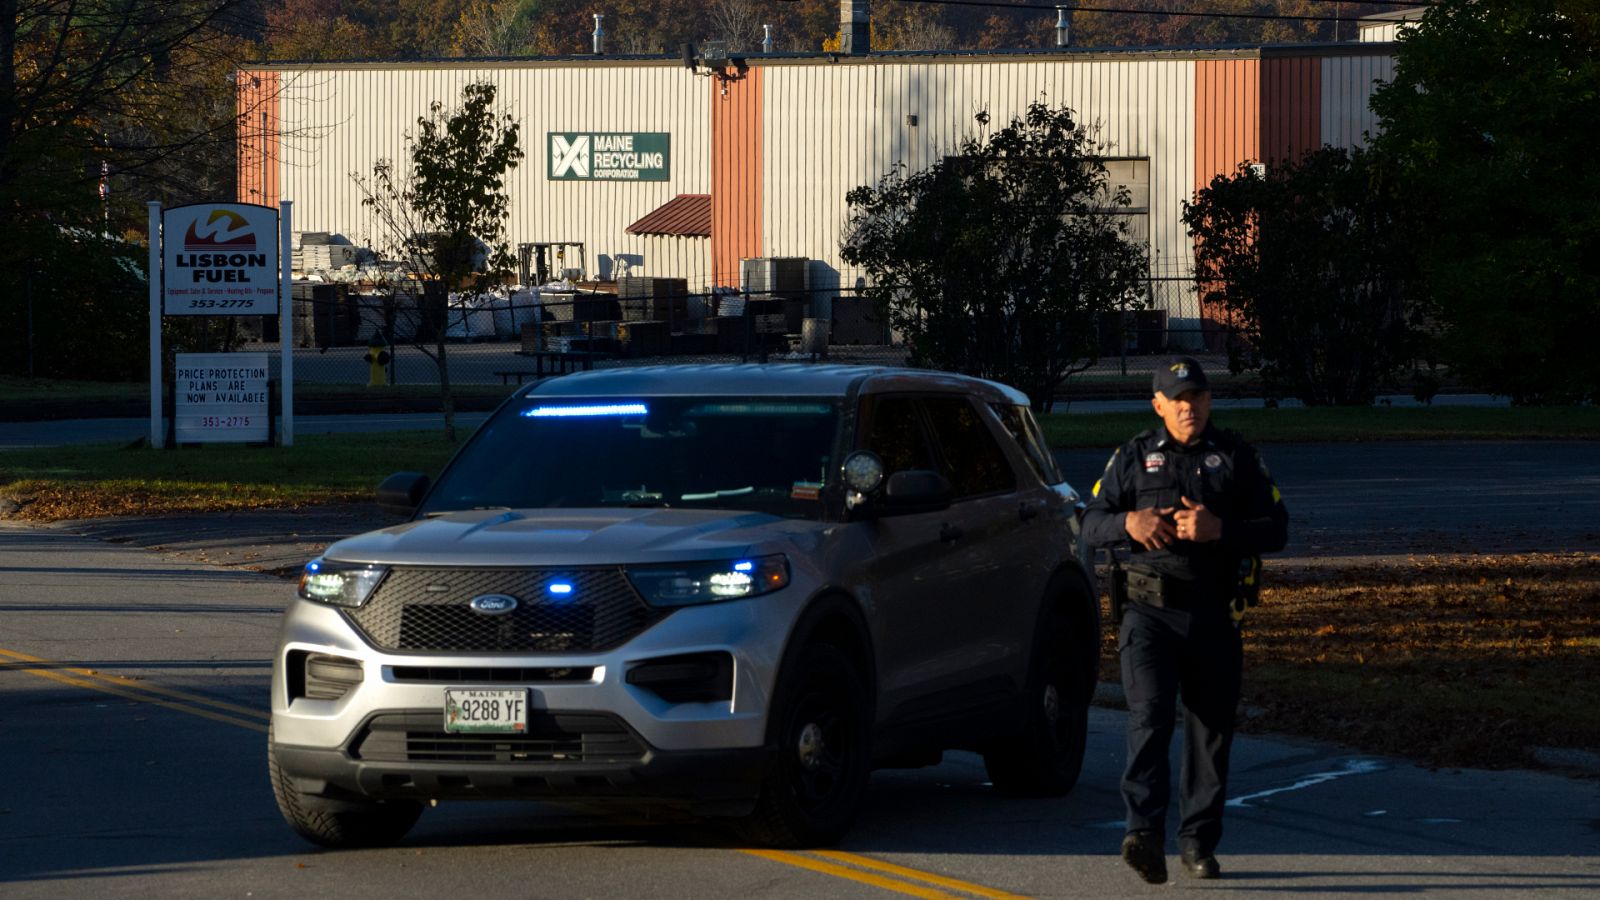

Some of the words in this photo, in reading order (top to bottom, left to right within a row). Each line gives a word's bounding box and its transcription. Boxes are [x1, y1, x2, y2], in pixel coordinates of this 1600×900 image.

[593, 135, 634, 151] MAINE
[593, 152, 663, 169] RECYCLING
[593, 169, 639, 178] CORPORATION
[176, 254, 266, 267] LISBON
[192, 269, 251, 283] FUEL
[256, 288, 274, 296] Propane
[188, 299, 255, 308] 353-2775
[178, 369, 205, 379] PRICE
[209, 368, 265, 379] PROTECTION
[189, 381, 218, 391] PLANS
[228, 381, 245, 391] ARE
[187, 393, 206, 403] NOW
[202, 416, 250, 427] 353-2775
[480, 598, 506, 609] Ford
[469, 690, 505, 698] MAINE
[462, 699, 500, 721] 9288
[505, 699, 524, 721] YF
